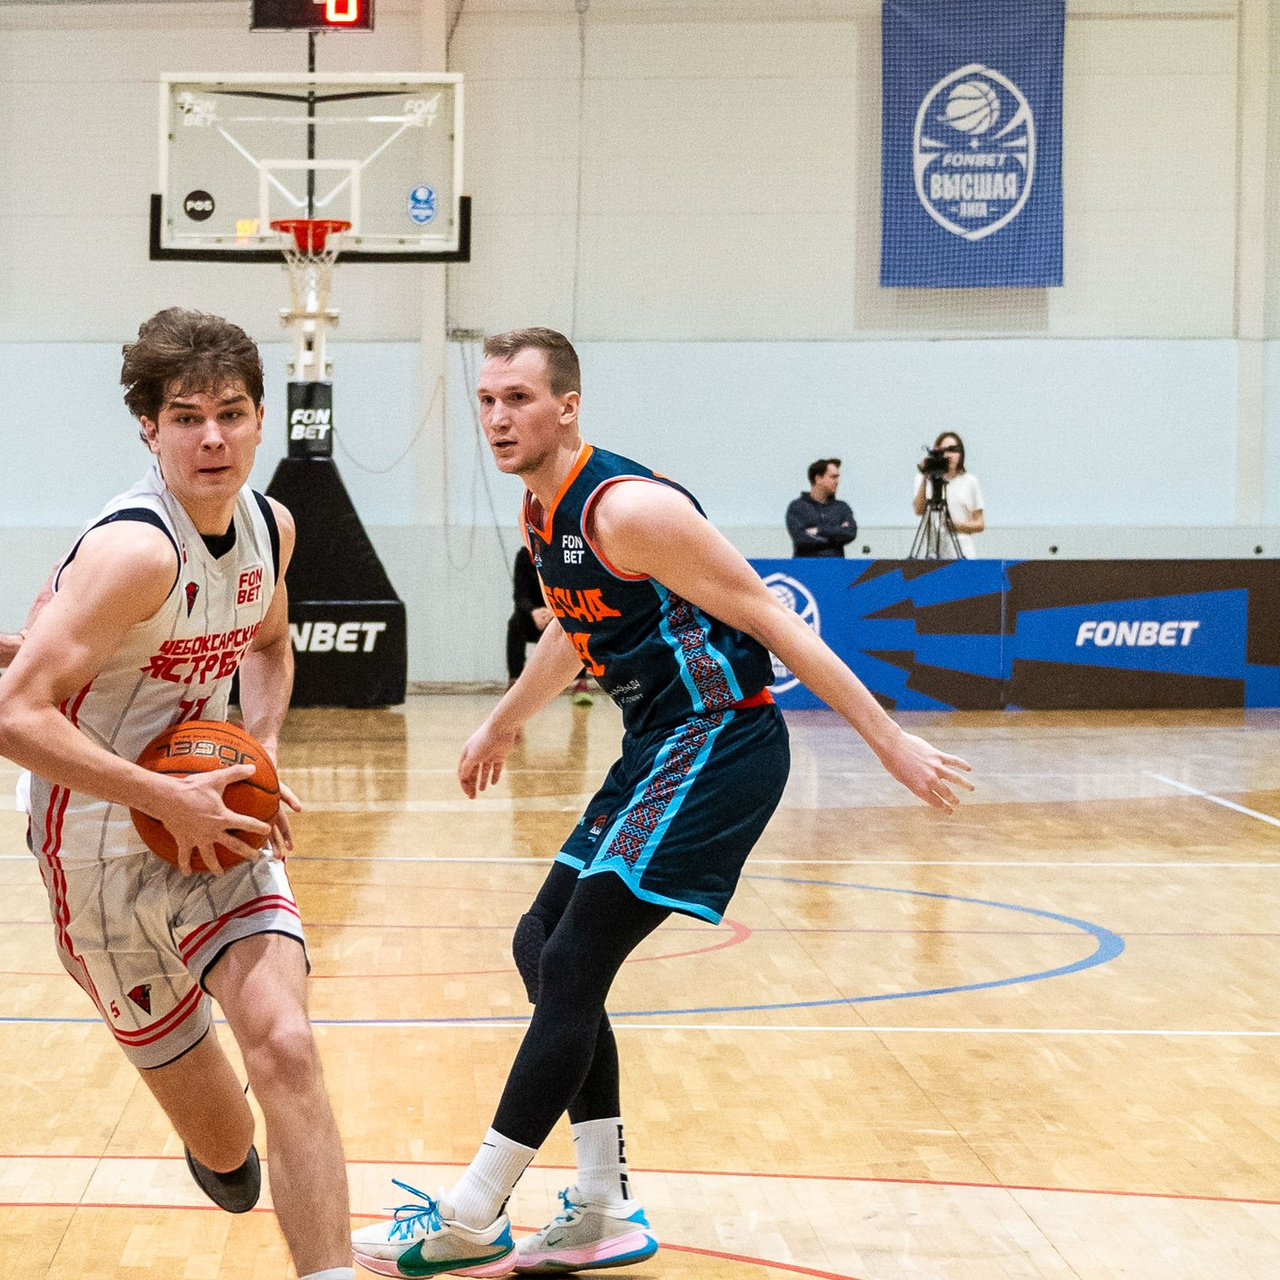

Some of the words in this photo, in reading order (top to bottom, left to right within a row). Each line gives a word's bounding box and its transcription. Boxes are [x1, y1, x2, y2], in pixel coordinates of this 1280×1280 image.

[941, 152, 1008, 167] FONBET
[930, 173, 1017, 200] ВЫСШАЯ
[290, 407, 331, 424] FON
[290, 423, 331, 440] BET
[562, 534, 584, 550] FON
[563, 550, 585, 564] BET
[238, 568, 264, 589] FON
[236, 585, 261, 605] BET
[288, 621, 387, 653] NBET
[1075, 621, 1200, 647] FONBET
